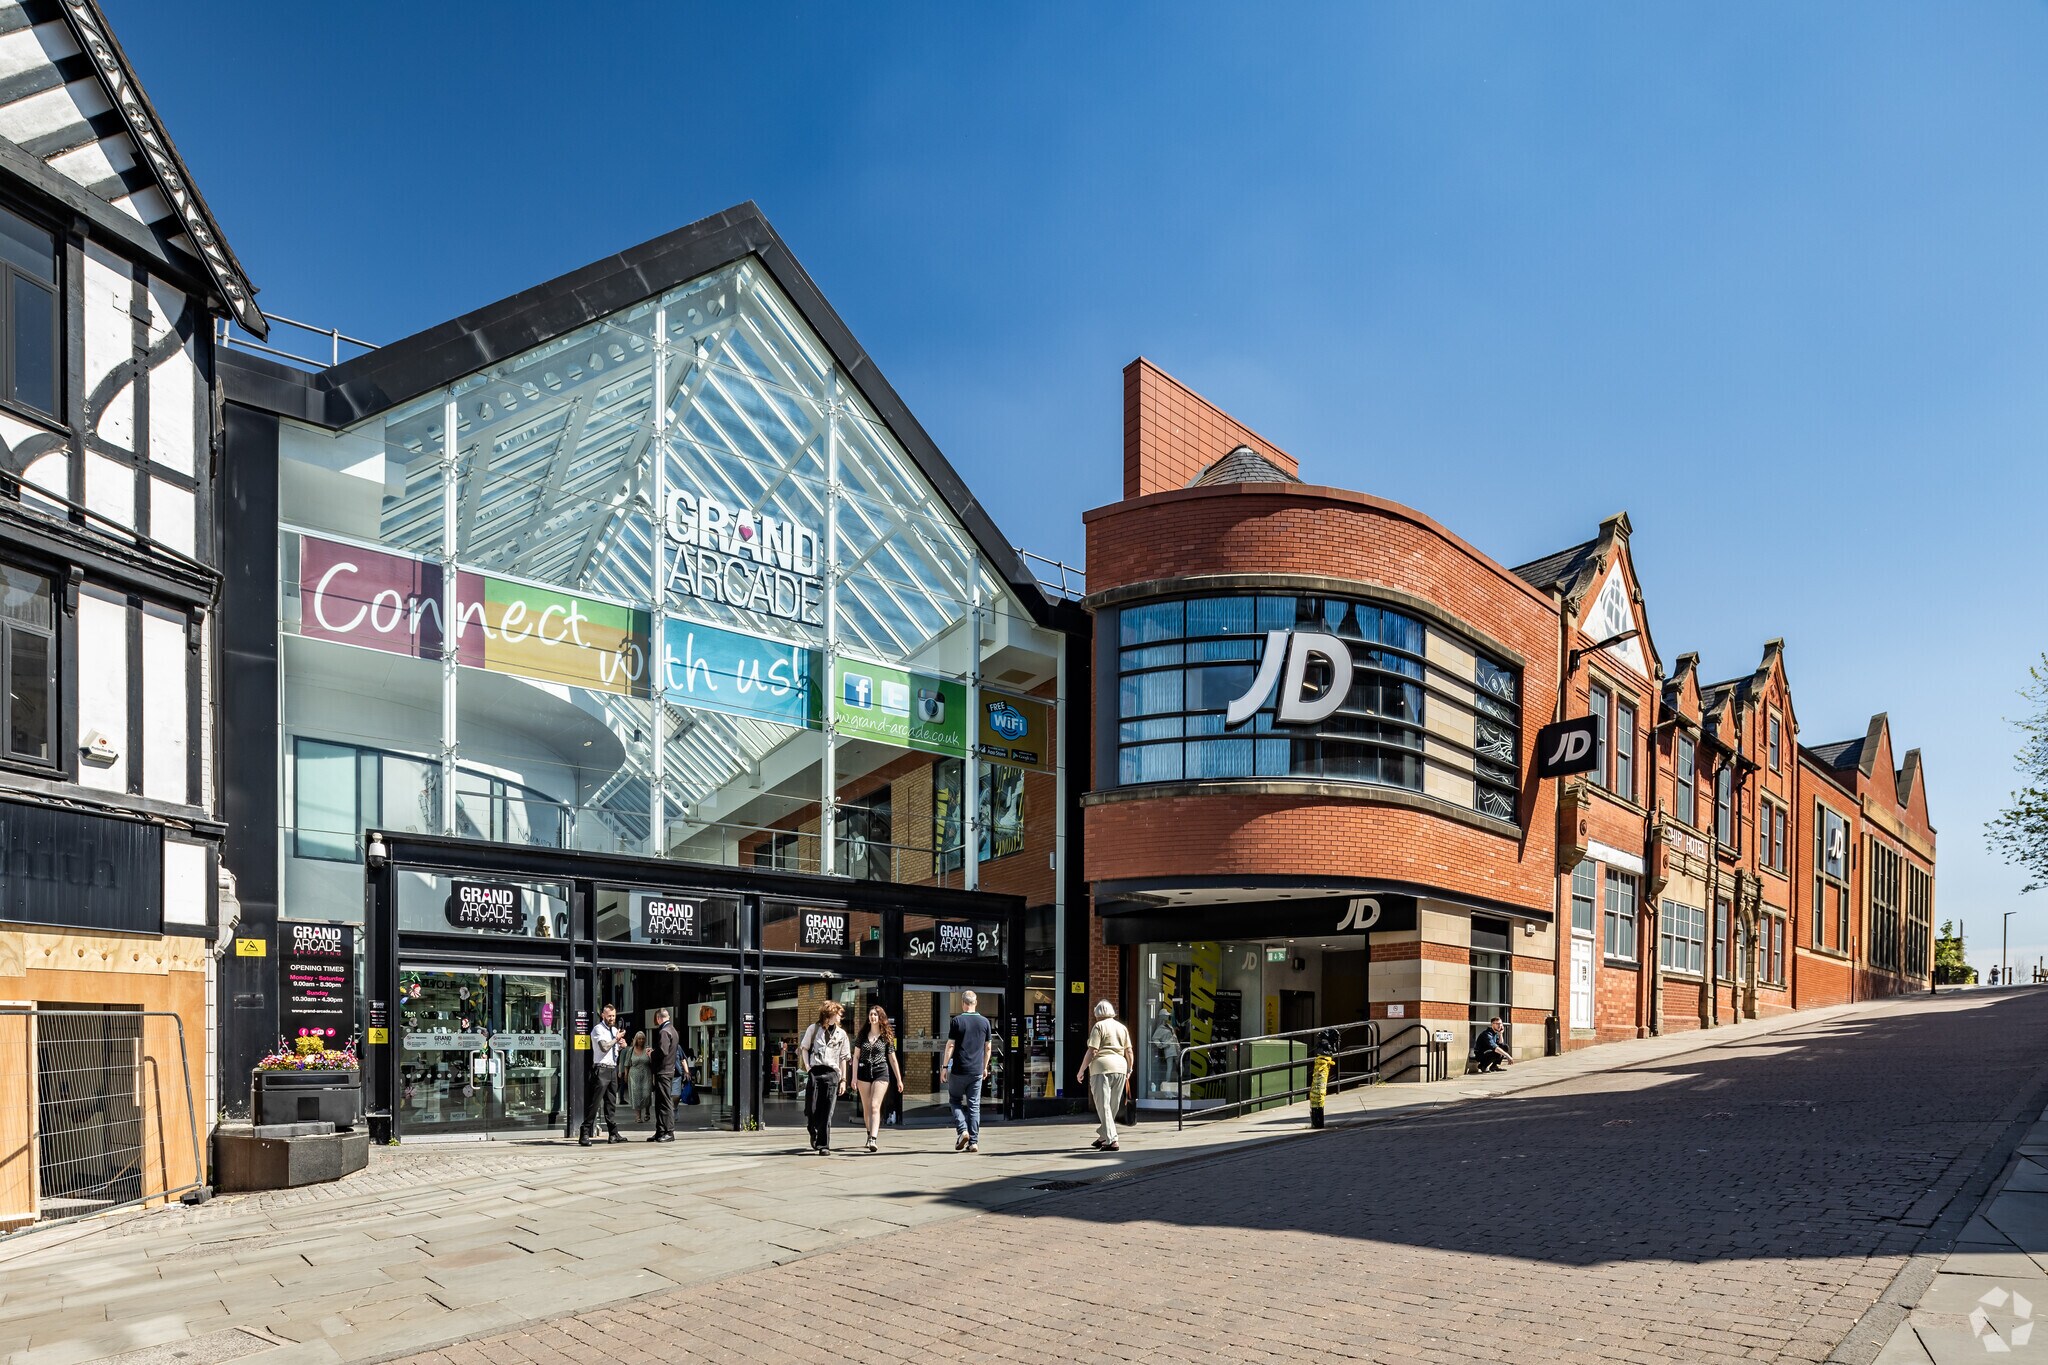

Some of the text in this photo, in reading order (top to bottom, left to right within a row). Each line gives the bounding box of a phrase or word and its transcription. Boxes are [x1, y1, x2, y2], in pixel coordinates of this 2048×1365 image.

[665, 489, 819, 576] GRAND
[666, 545, 824, 627] ARCADE
[314, 562, 804, 698] Connect wth us!
[1226, 630, 1354, 725] JD
[990, 702, 1005, 711] FREE
[819, 710, 960, 746] w.grand-arcade.co.uk
[994, 714, 1023, 731] WiFi
[1548, 730, 1591, 766] JD
[1686, 834, 1706, 859] HOTEL
[1828, 828, 1843, 859] JD
[460, 886, 513, 905] GRAND
[460, 902, 513, 919] ARCADE
[649, 901, 693, 918] GRAND
[1337, 898, 1381, 931] JD
[460, 916, 513, 924] SHOPPING
[649, 916, 693, 931] ARCADE
[806, 914, 844, 929] GRAND
[293, 925, 341, 940] GRAND
[648, 928, 693, 936] SHOPPING
[806, 927, 843, 941] ARCADE
[940, 925, 973, 939] GRAND
[293, 939, 341, 952] ARCADE
[940, 937, 973, 950] ARCADE
[290, 964, 322, 972] OPENING
[1241, 951, 1258, 971] JD
